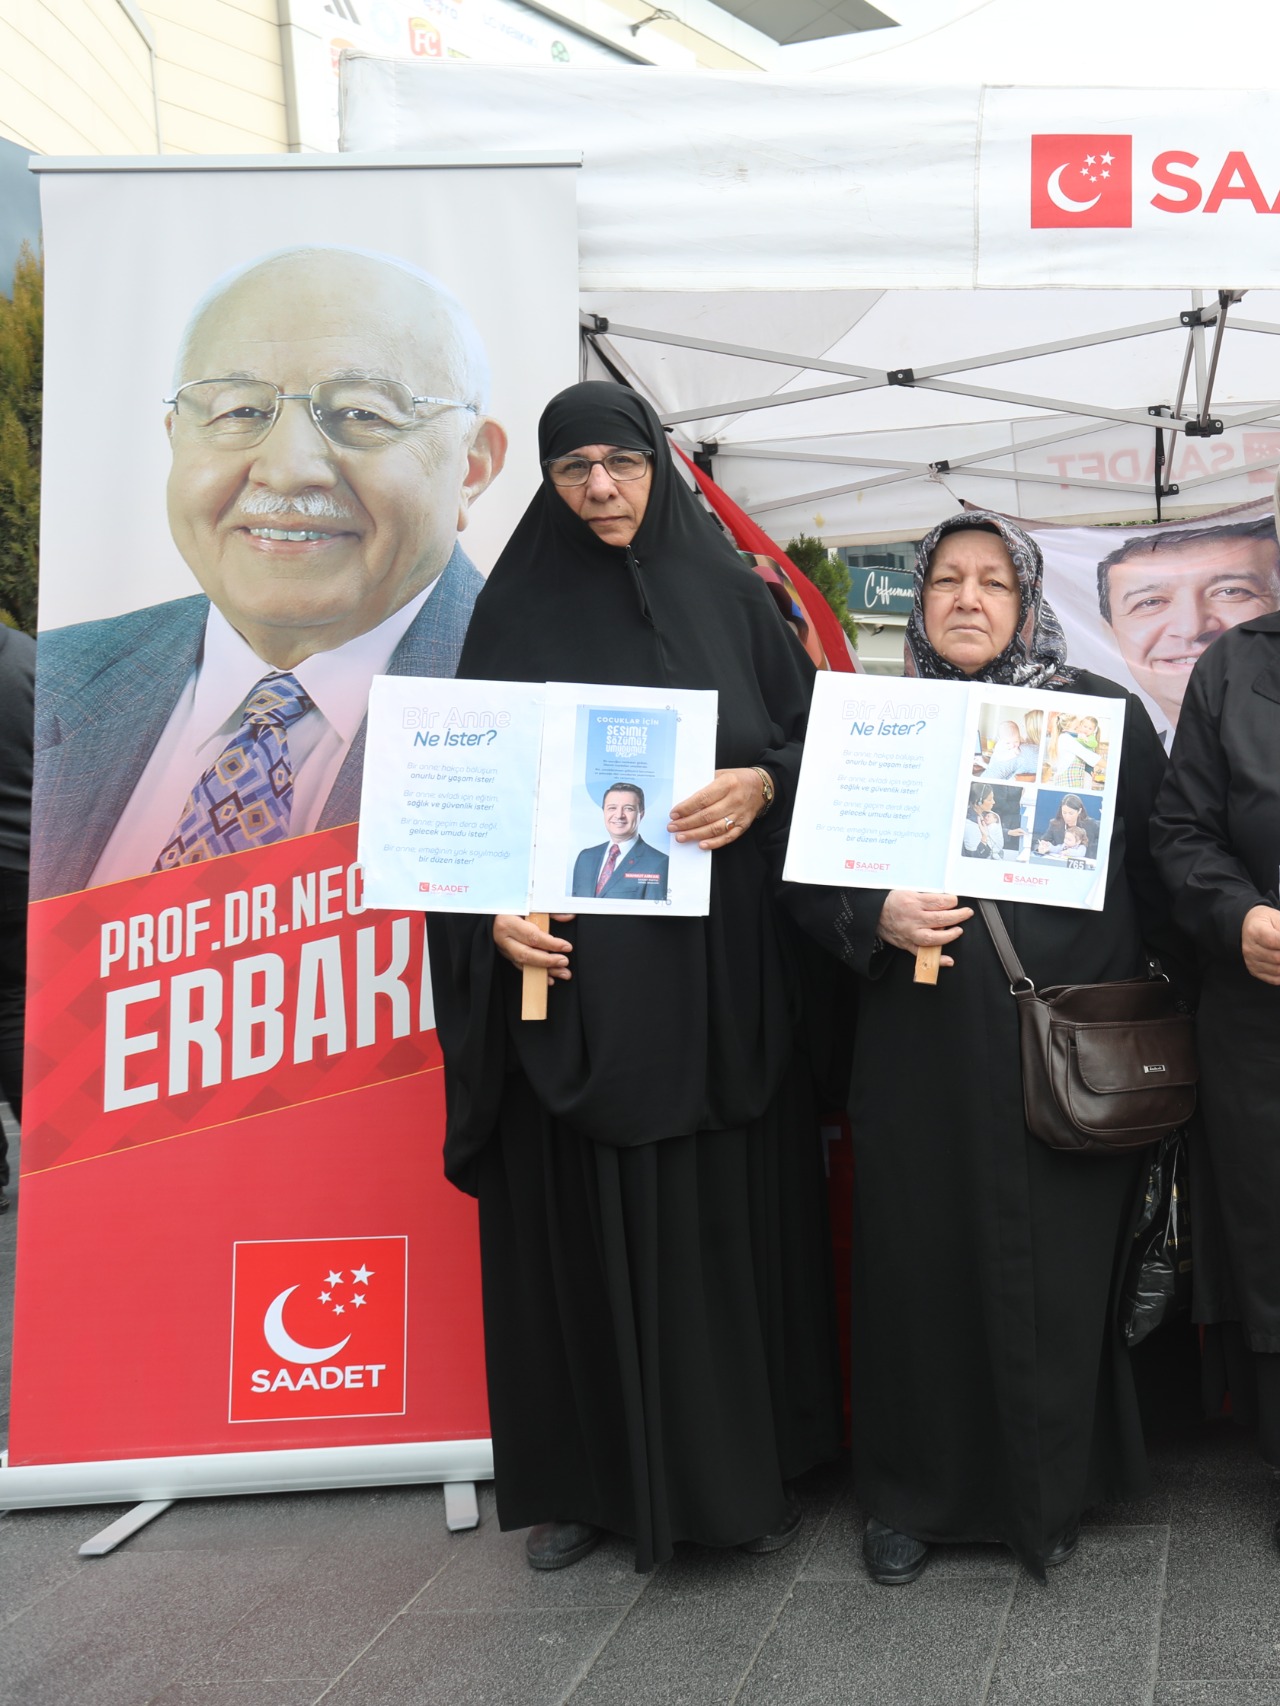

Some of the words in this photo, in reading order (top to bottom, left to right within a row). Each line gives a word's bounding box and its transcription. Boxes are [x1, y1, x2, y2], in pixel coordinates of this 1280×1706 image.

[841, 699, 877, 720] Bir
[877, 699, 940, 720] Anne
[402, 706, 440, 730] Bir
[443, 706, 512, 729] Anne
[597, 716, 640, 725] ÇOCUKLAR
[850, 721, 875, 736] Ne
[877, 719, 926, 736] İster?
[413, 731, 440, 747] Ne
[444, 728, 498, 747] İster?
[407, 762, 418, 770] Bir
[410, 772, 435, 780] onurlu
[436, 773, 447, 781] bir
[448, 775, 474, 784] yaşam
[474, 776, 495, 784] ister!
[407, 800, 429, 809] sağlık
[441, 801, 473, 810] güvenlik
[474, 803, 494, 811] ister!
[440, 829, 467, 837] umudu
[418, 855, 429, 863] bir
[454, 857, 475, 865] ister!
[1068, 859, 1085, 870] 765
[856, 861, 891, 871] SAADET
[1015, 875, 1050, 886] SAADET
[431, 884, 470, 893] SAADET
[100, 862, 366, 978] PROF.DR.NEC
[104, 917, 437, 1113] ERBAK
[250, 1364, 386, 1392] SAADET
